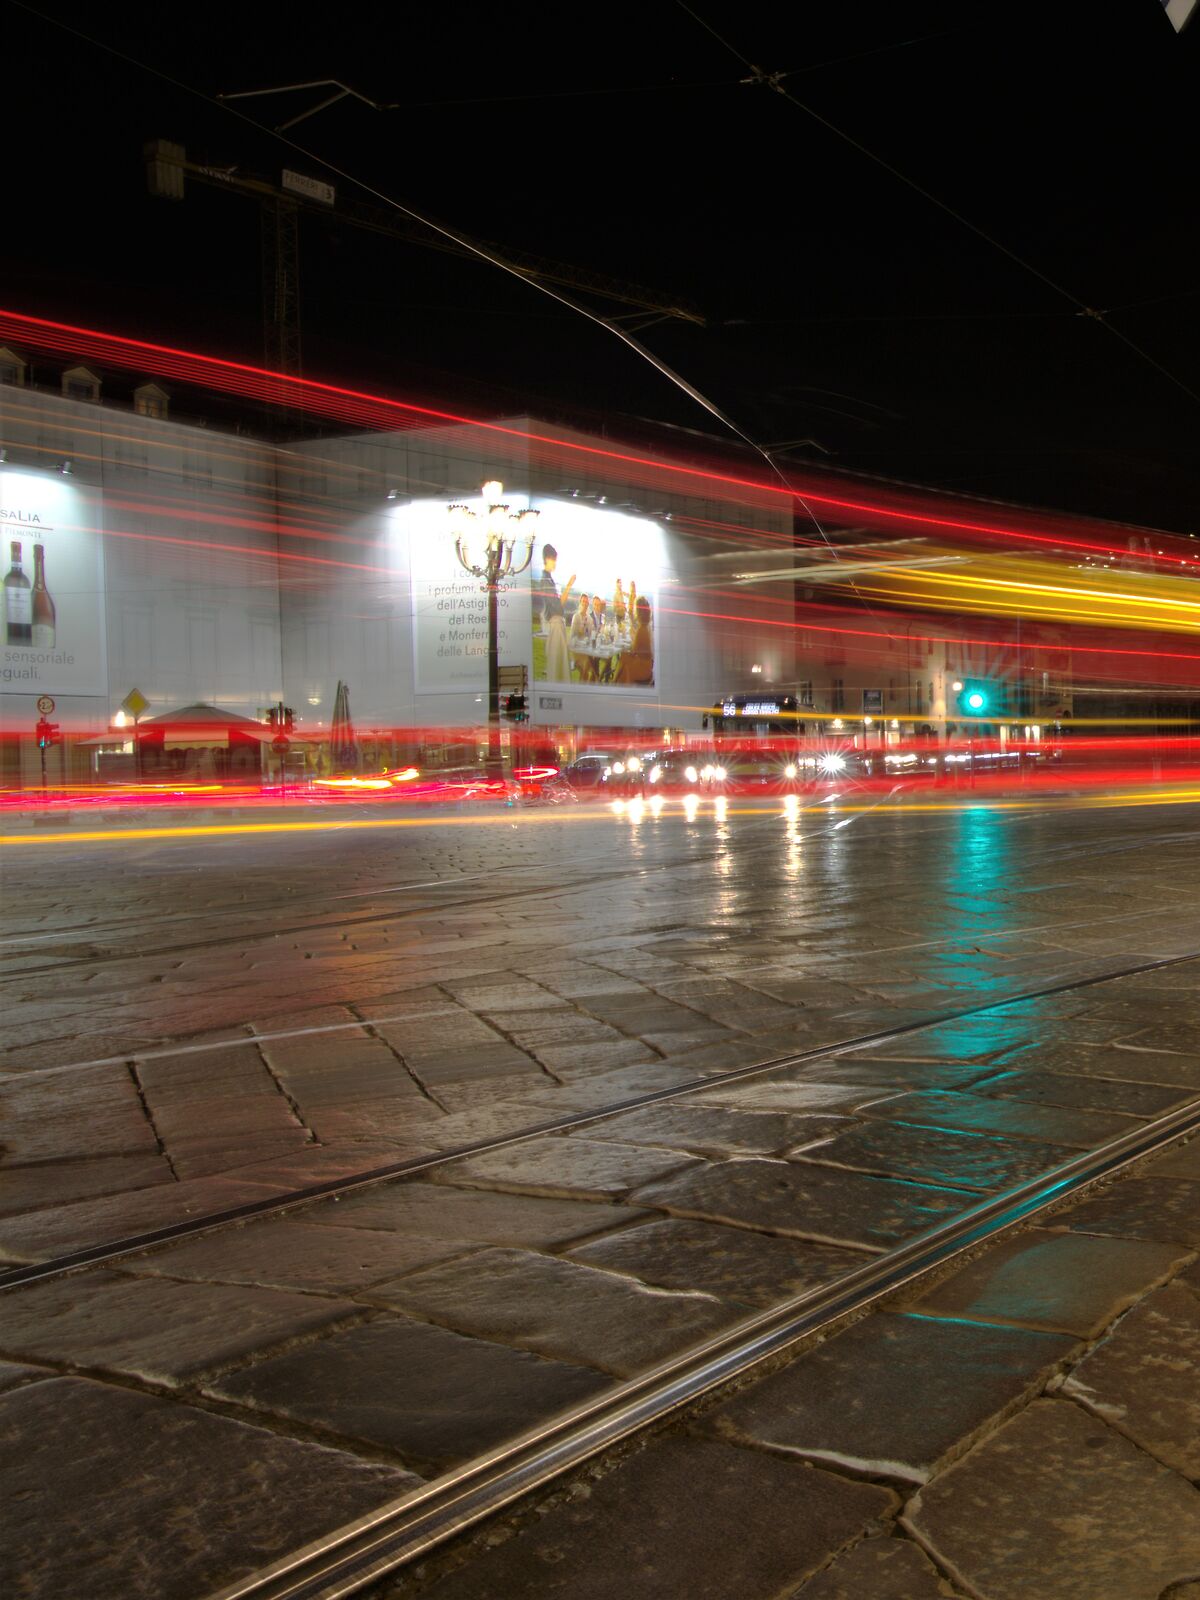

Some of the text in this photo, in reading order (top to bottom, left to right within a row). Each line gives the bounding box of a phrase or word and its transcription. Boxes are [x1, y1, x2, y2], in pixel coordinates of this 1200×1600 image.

[437, 597, 509, 611] dell'Astigio,
[448, 613, 489, 625] del Roe
[448, 628, 508, 641] Monferro,
[4, 650, 75, 664] sensoriale
[437, 645, 512, 658] delle Lange...
[0, 665, 41, 681] guali.
[723, 704, 736, 716] 56
